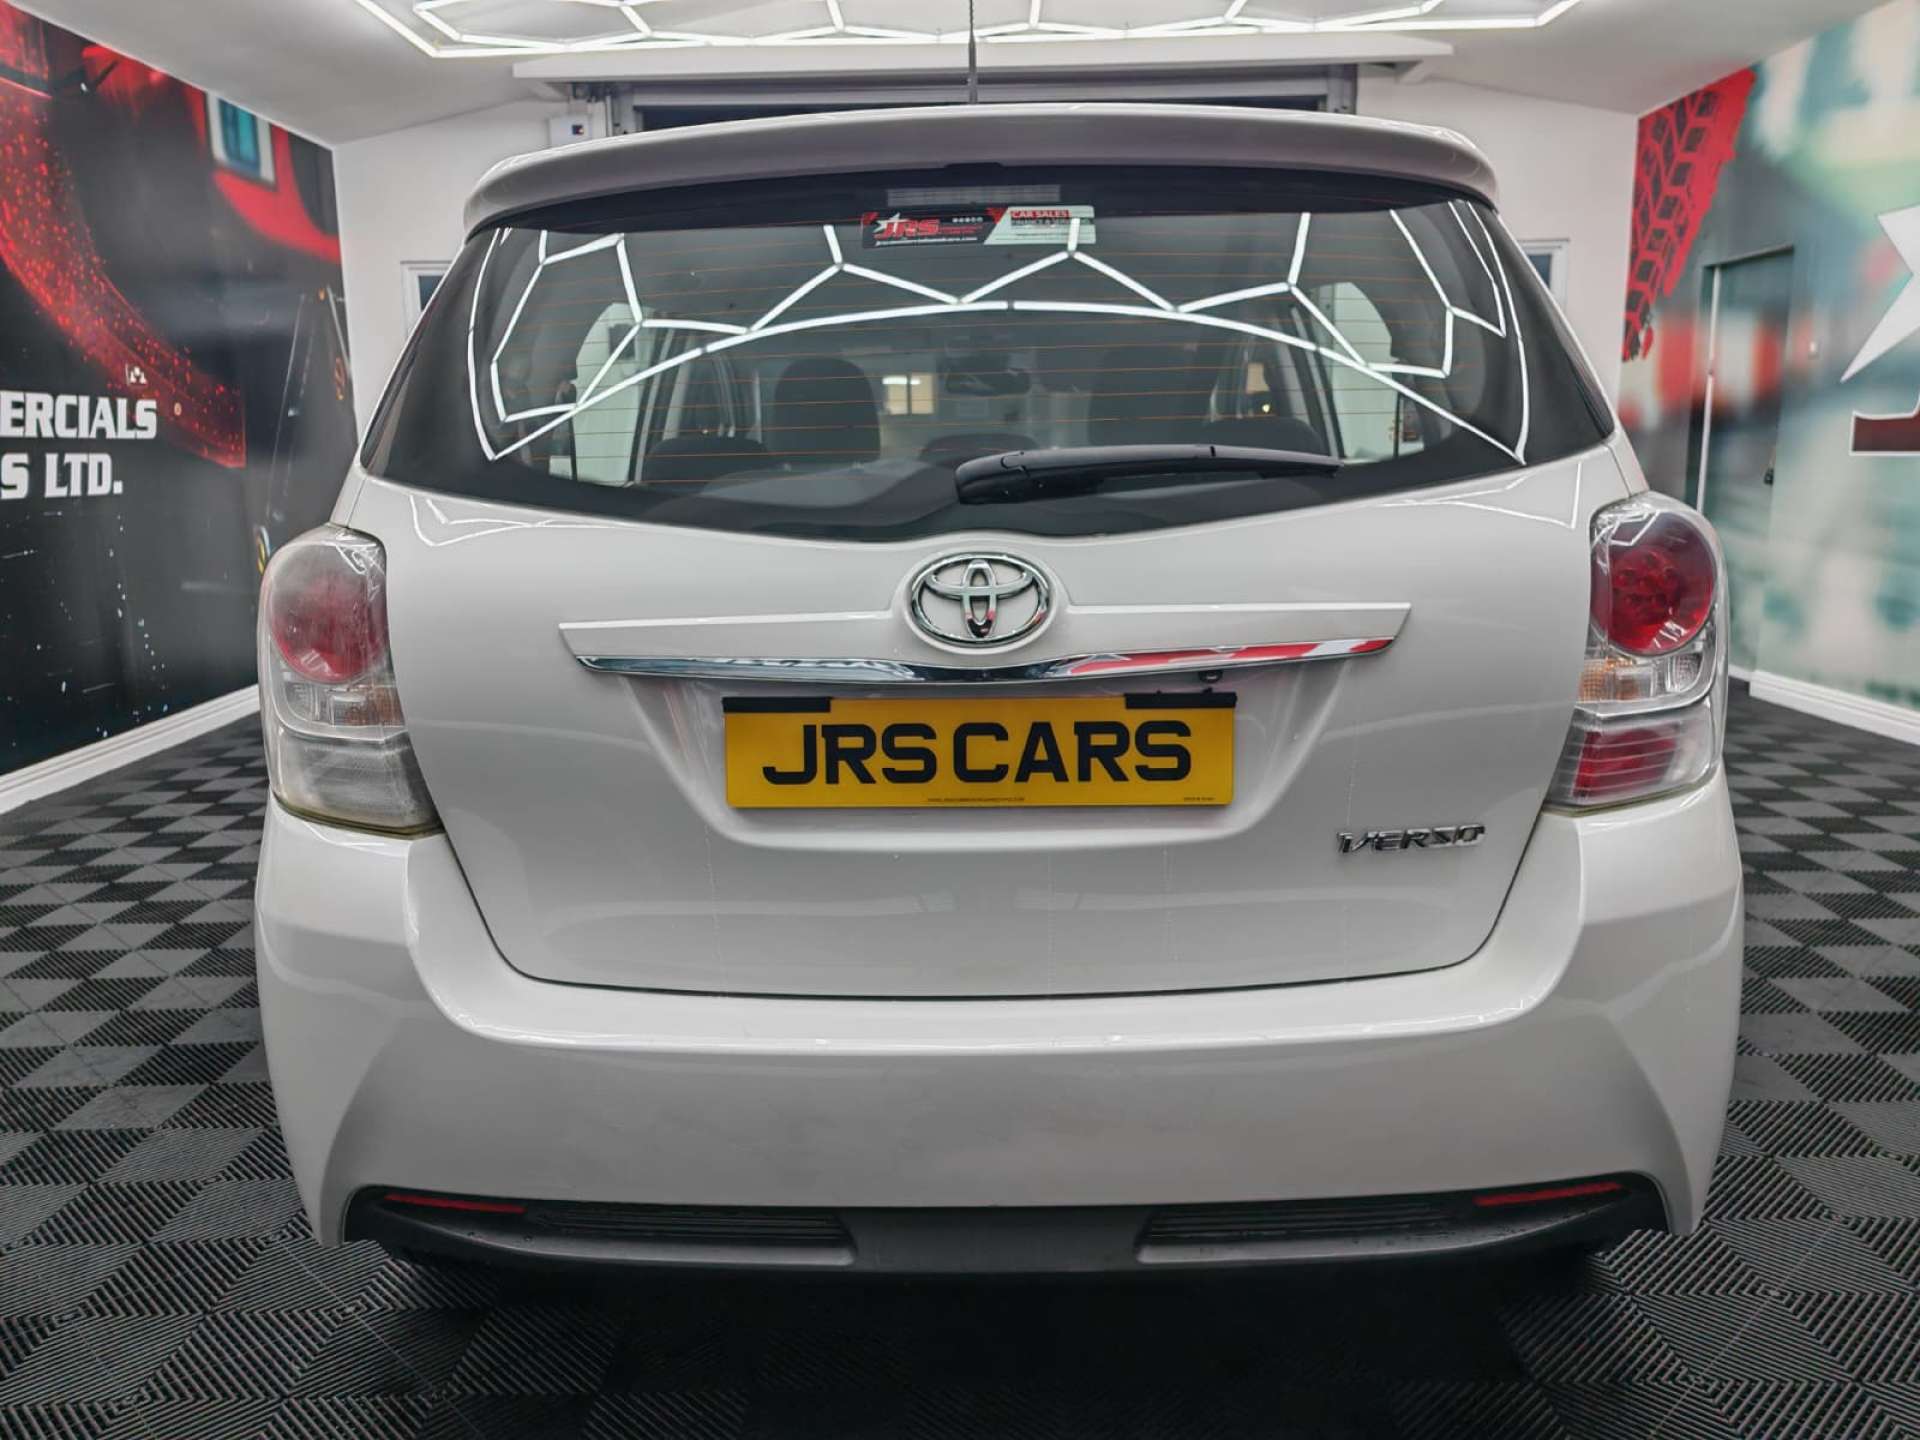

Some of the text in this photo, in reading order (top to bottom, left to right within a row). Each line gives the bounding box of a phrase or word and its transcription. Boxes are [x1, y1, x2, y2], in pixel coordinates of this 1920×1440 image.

[873, 217, 940, 240] JRS
[0, 390, 157, 439] ERCIALS
[44, 452, 124, 498] LTD.
[762, 720, 1192, 785] JRS CARS
[1336, 823, 1486, 853] VERSO
